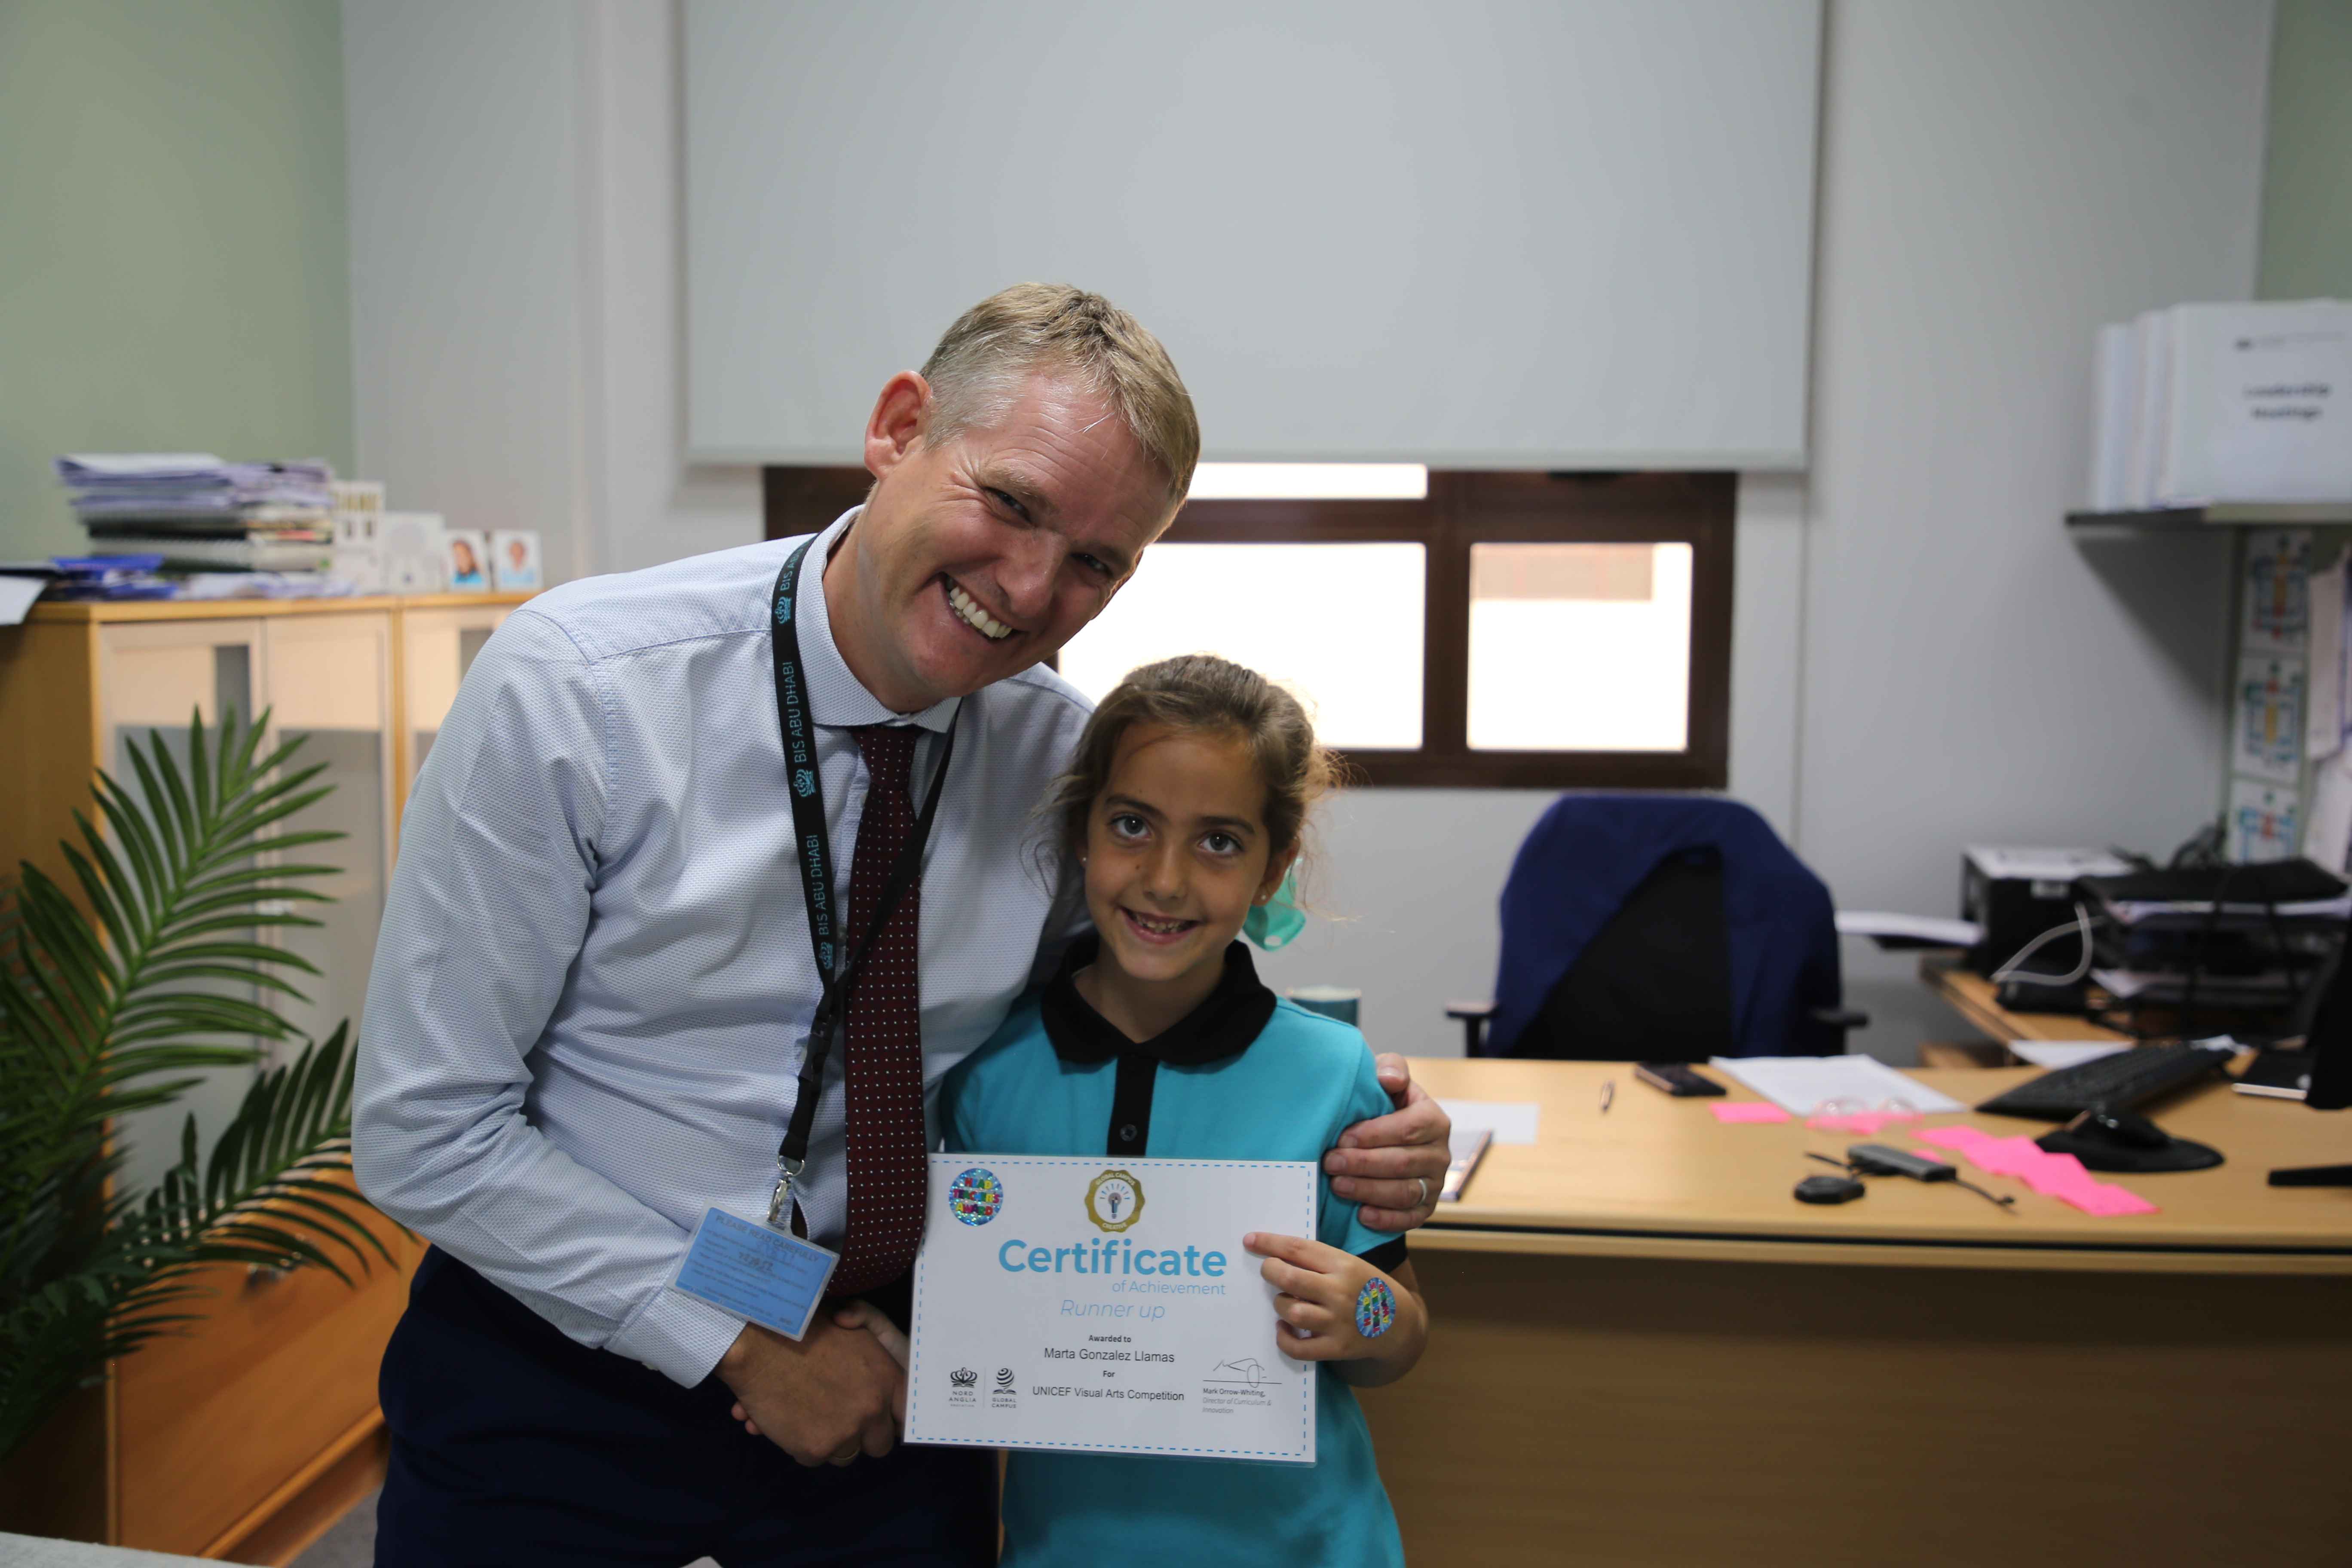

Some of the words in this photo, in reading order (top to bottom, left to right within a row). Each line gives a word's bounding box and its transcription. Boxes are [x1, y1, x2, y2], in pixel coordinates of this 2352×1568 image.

[780, 571, 793, 591] BIS
[782, 662, 799, 705] DHABI
[788, 709, 803, 737] ABU
[792, 740, 807, 763] BIS
[806, 835, 822, 877] DHABI
[812, 882, 827, 910] ABU
[817, 913, 829, 935] BIS
[965, 1177, 993, 1190] HEAD
[956, 1203, 993, 1216] AWARD
[716, 1215, 747, 1232] PLEASE
[748, 1229, 772, 1243] READ
[774, 1239, 819, 1262] CAREFULLY
[998, 1237, 1227, 1277] Certificate
[1112, 1280, 1127, 1292] of
[1129, 1281, 1226, 1295] Achievement
[1060, 1299, 1134, 1317] Runner
[1139, 1305, 1165, 1322] up
[1378, 1283, 1390, 1323] AWARD
[1044, 1348, 1075, 1359] Marta
[1079, 1349, 1131, 1361] Gonzalez
[1135, 1351, 1175, 1362] Llamas
[1032, 1386, 1071, 1396] UNICEF
[1075, 1387, 1103, 1397] Visual
[1106, 1389, 1124, 1398] Arts
[1127, 1390, 1185, 1401] Competition
